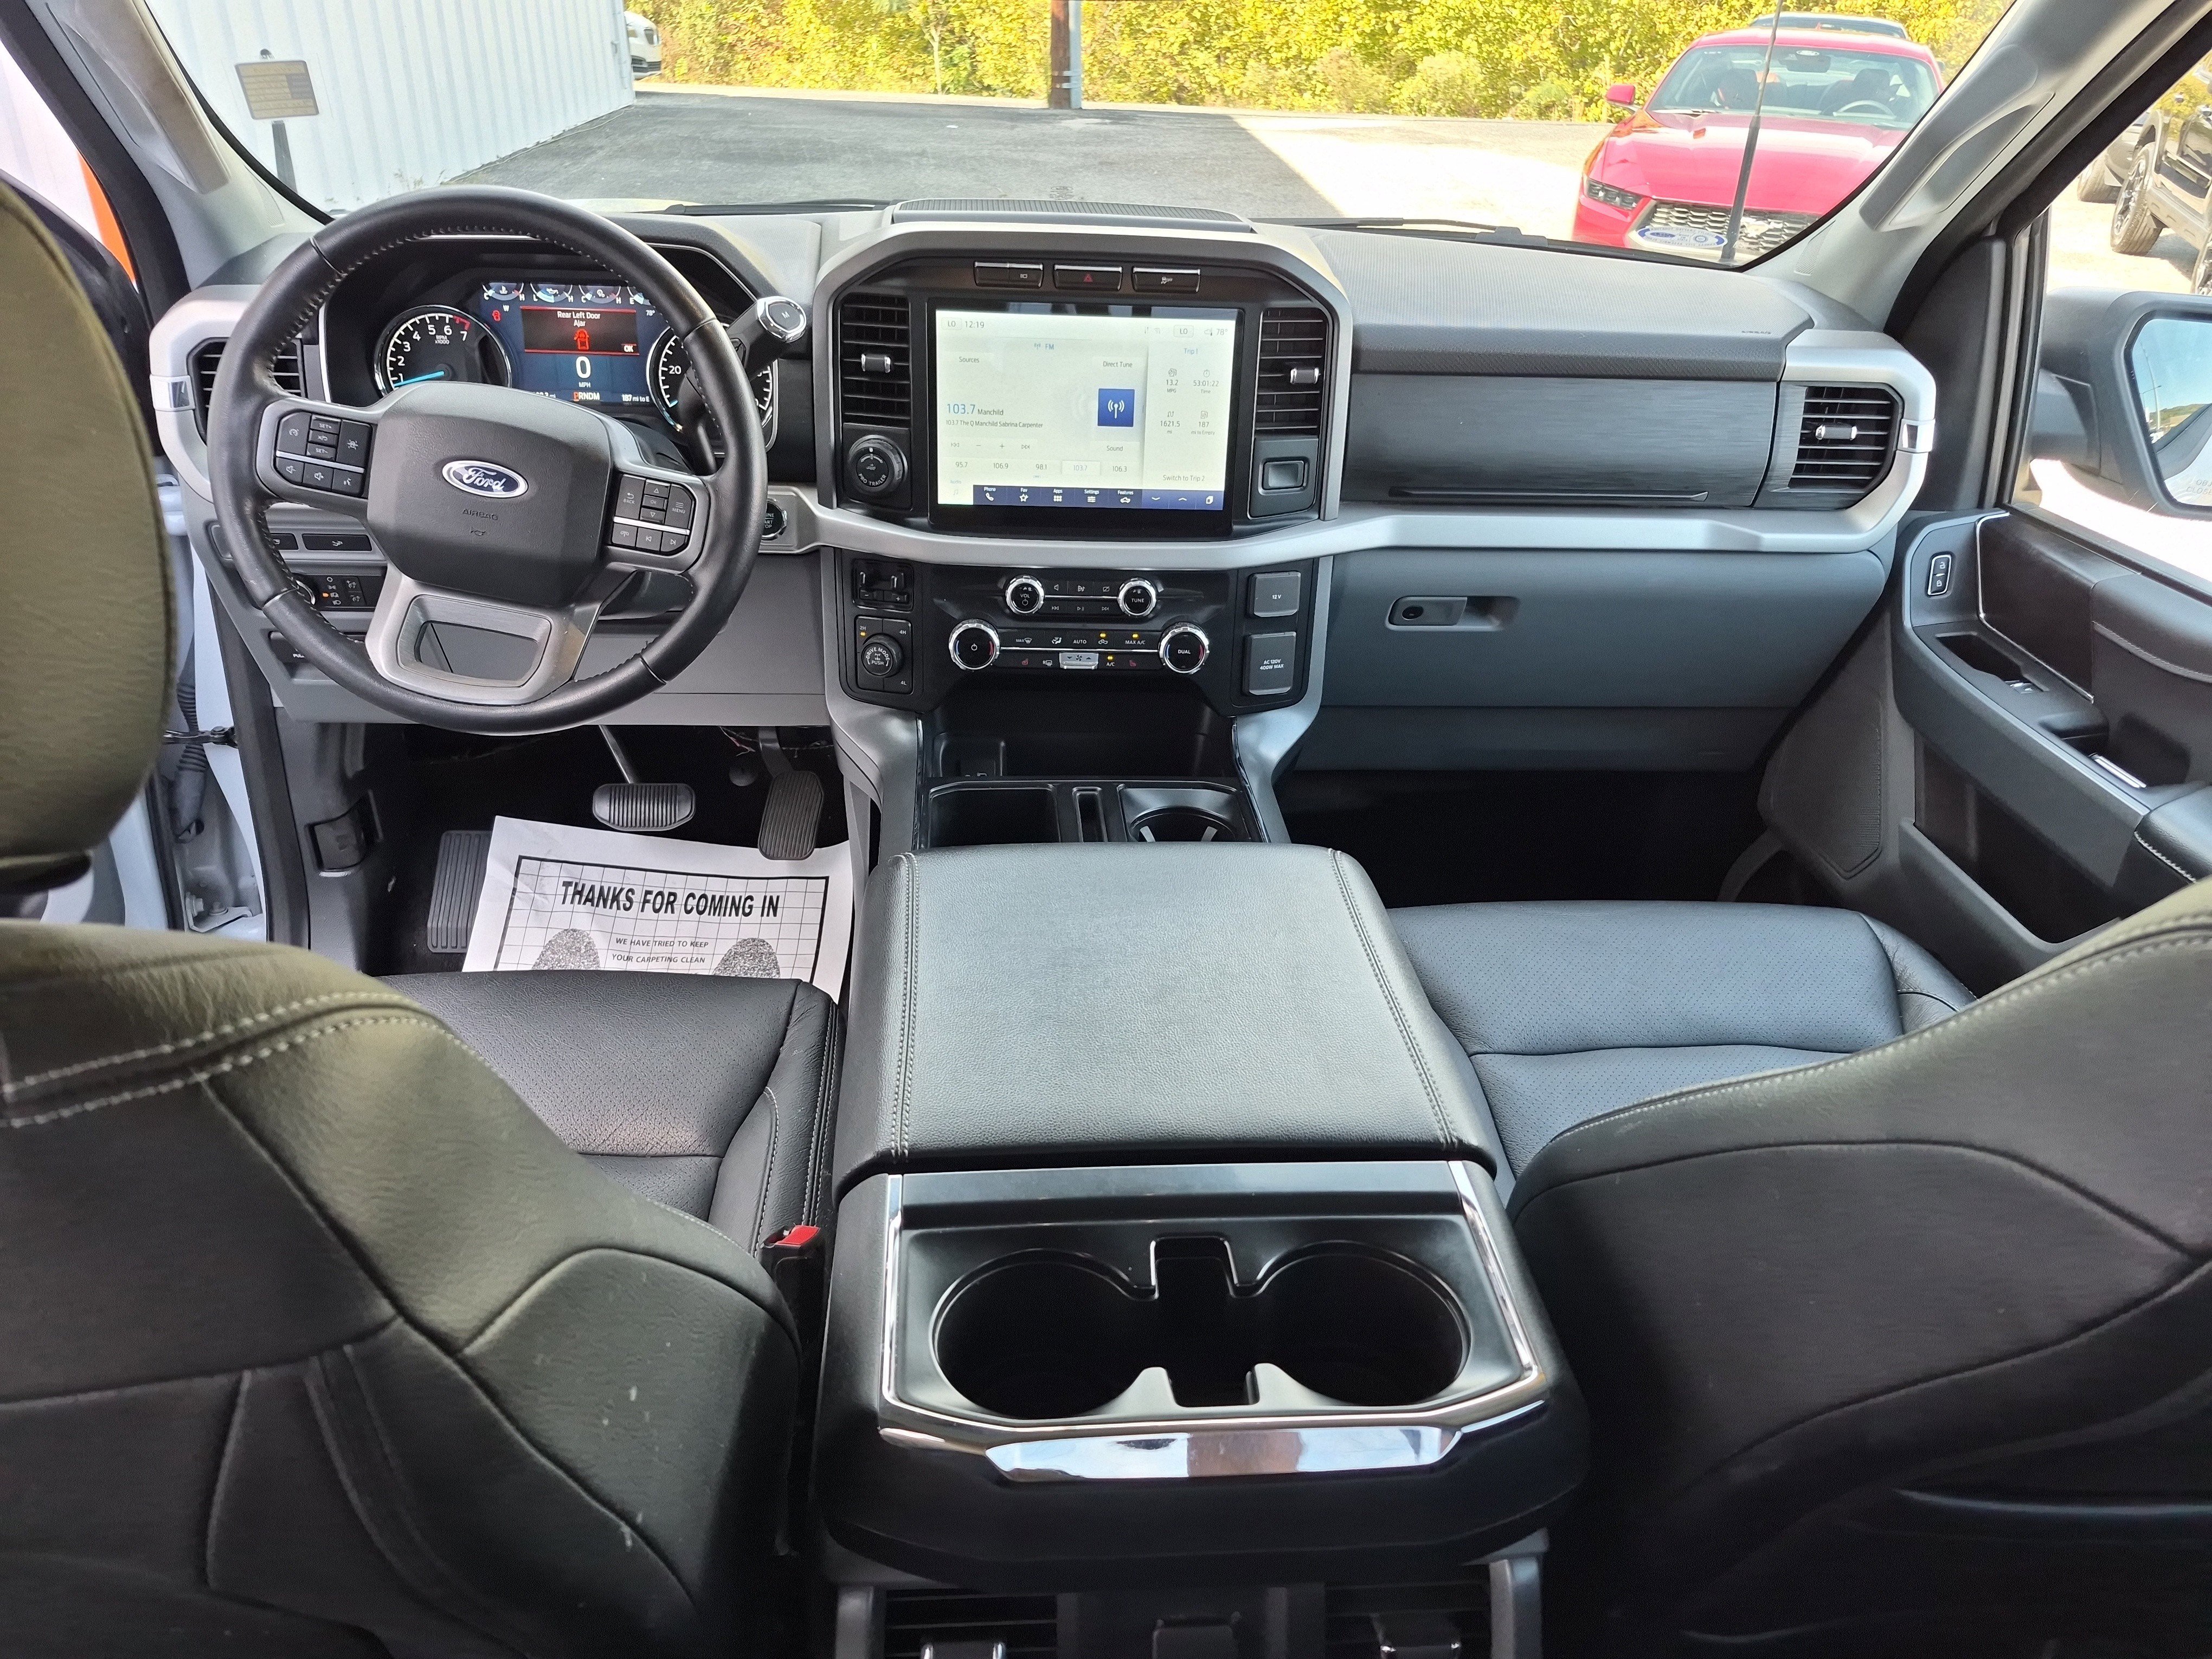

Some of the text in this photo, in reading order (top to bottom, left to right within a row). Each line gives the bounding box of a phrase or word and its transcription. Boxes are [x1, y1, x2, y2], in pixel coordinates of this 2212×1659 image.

[581, 295, 587, 303] C
[427, 324, 436, 335] 5
[443, 325, 452, 335] 6
[413, 331, 421, 342] 4
[460, 331, 467, 342] 7
[403, 342, 411, 352] 3
[397, 356, 406, 366] 2
[576, 356, 591, 378] 0
[668, 365, 682, 374] 20
[398, 373, 403, 383] 1
[947, 403, 976, 414] 103.7
[463, 467, 506, 490] Ford
[858, 473, 887, 486] PRO TRAILER
[866, 647, 890, 660] DRIVE MODE
[561, 880, 780, 918] THANKS FOR COMING IN
[616, 937, 628, 946] WE
[629, 938, 651, 947] HAVE
[653, 940, 675, 948] TRIED
[612, 953, 633, 962] YOUR
[636, 955, 678, 963] CARPETING
